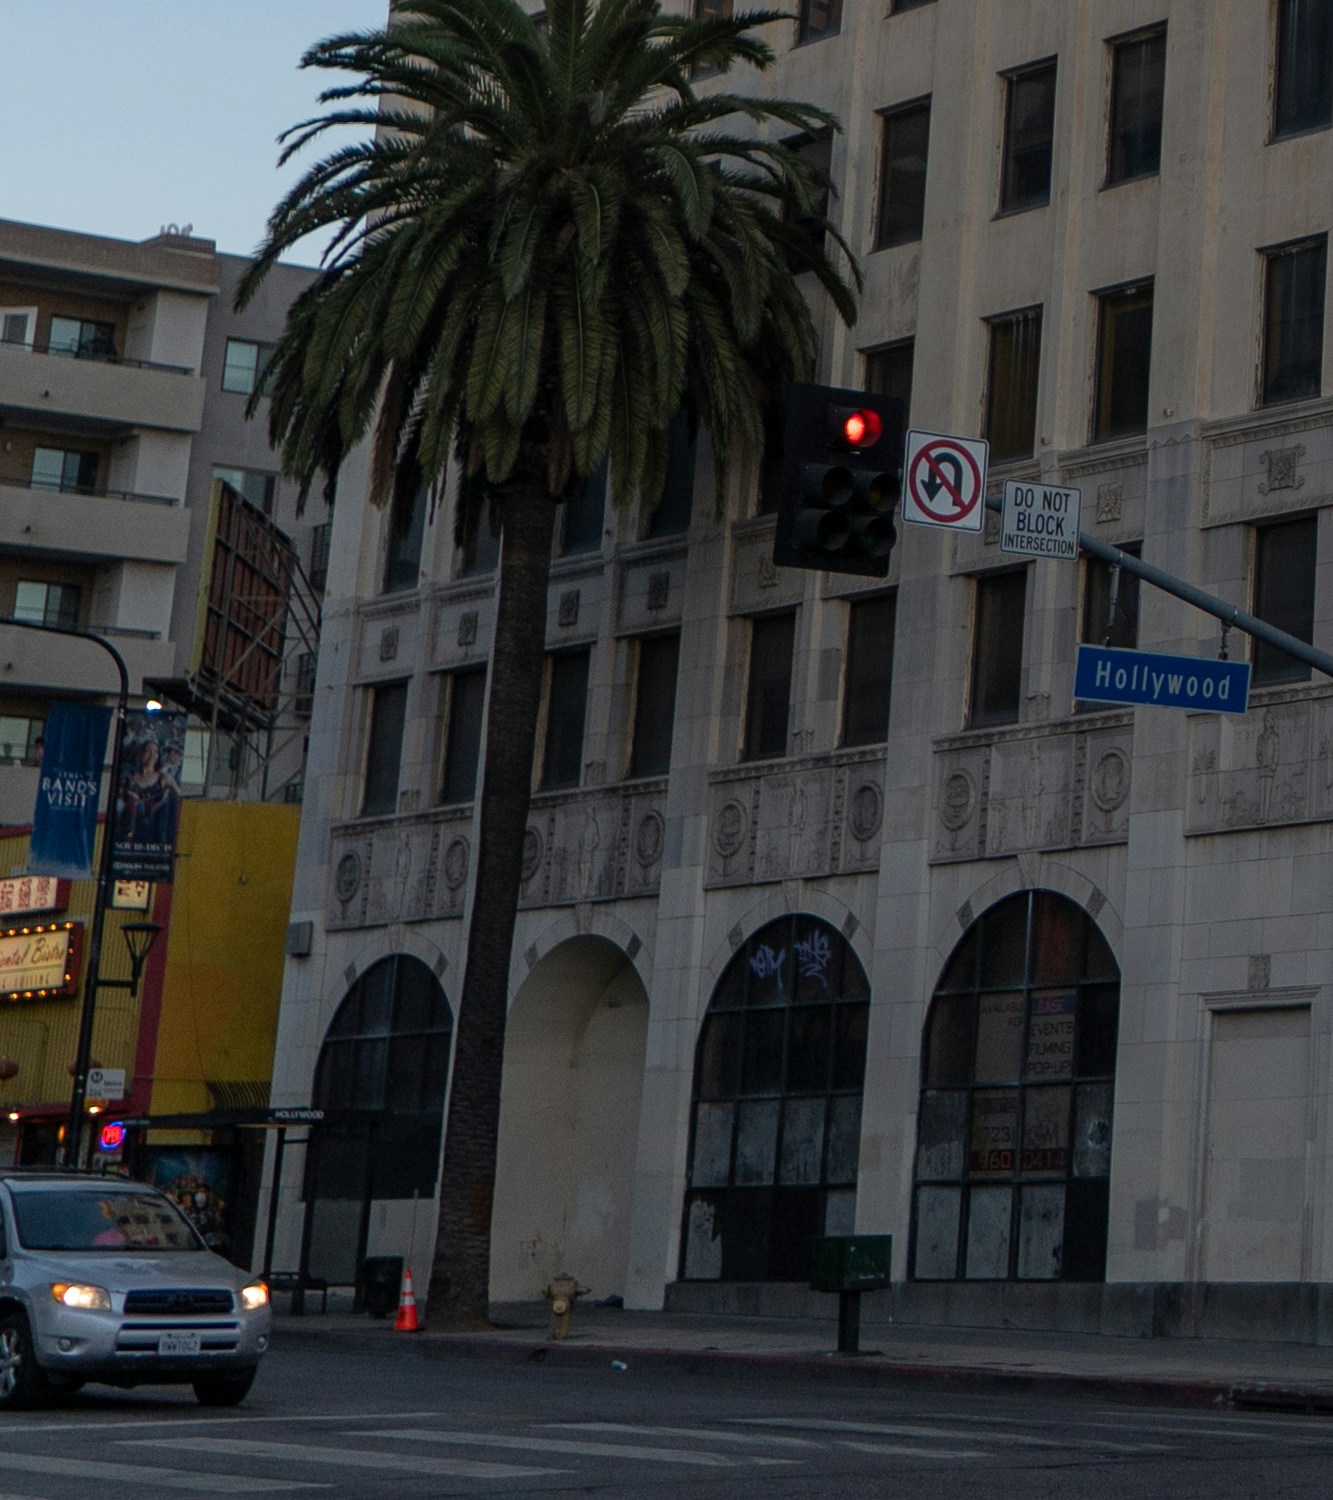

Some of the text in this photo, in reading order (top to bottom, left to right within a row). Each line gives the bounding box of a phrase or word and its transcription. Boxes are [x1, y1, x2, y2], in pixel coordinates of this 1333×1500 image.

[1014, 487, 1071, 513] DO NOT
[1016, 511, 1064, 536] BLOCK
[1003, 533, 1075, 555] INTERSECTION
[1095, 660, 1231, 700] Hollywood
[47, 790, 88, 807] VISIT
